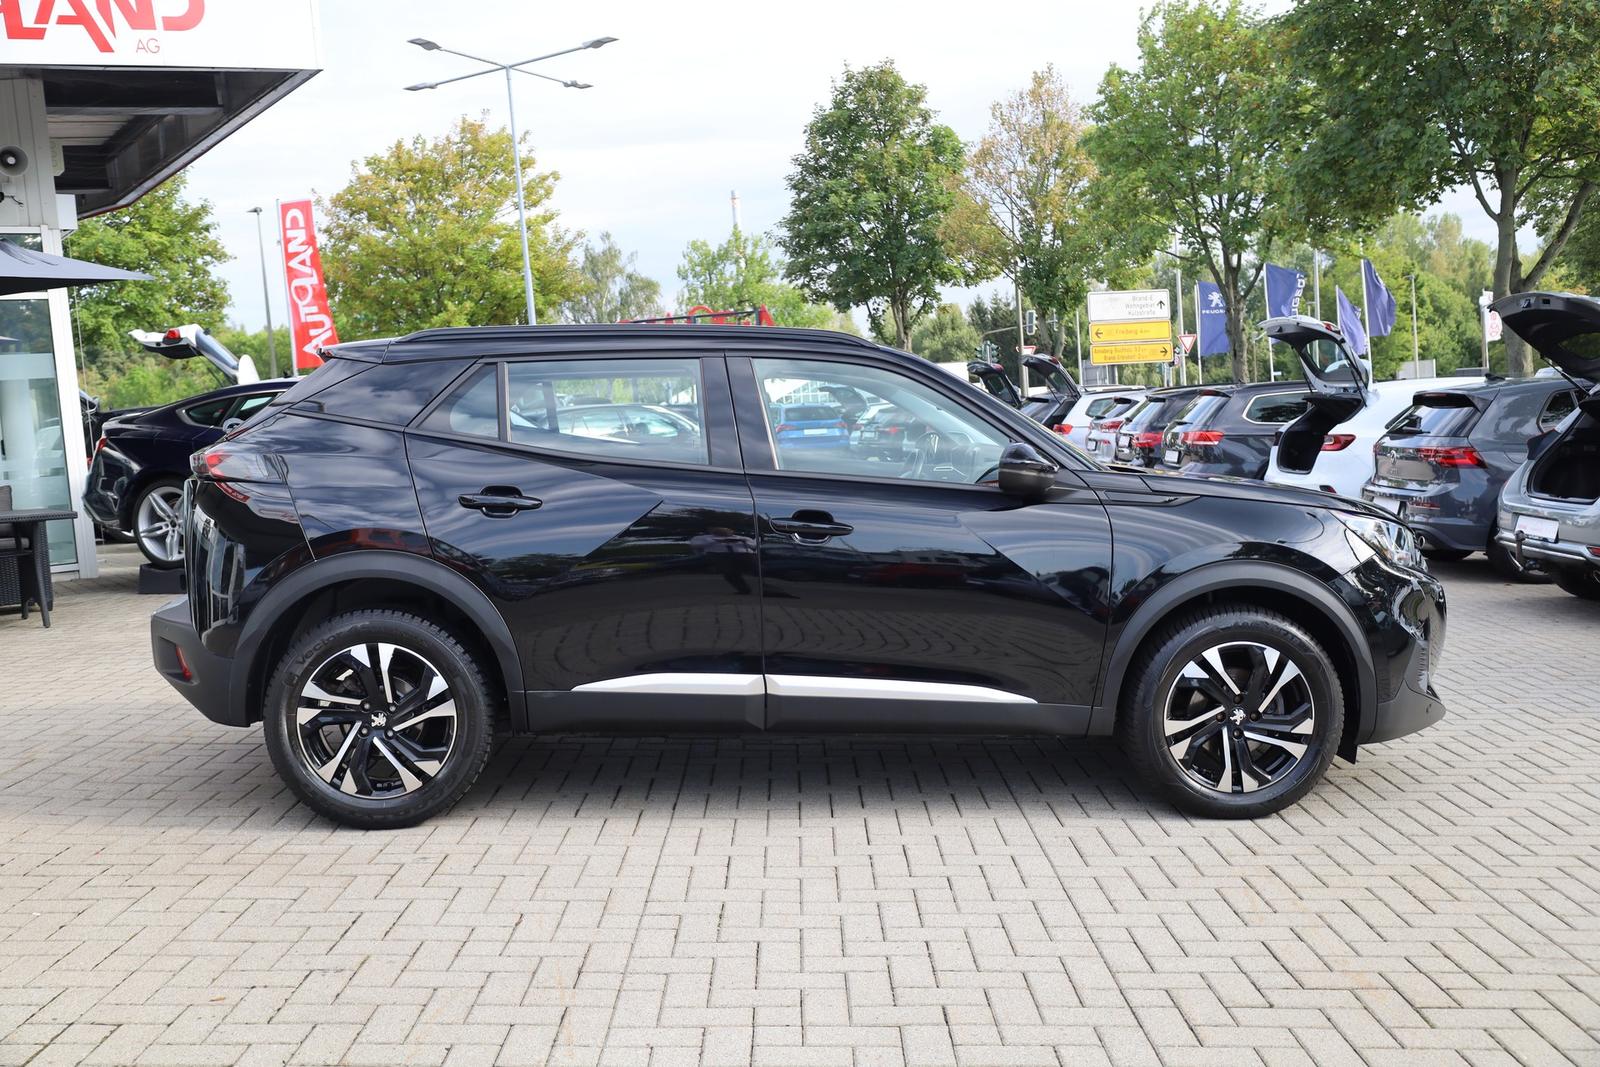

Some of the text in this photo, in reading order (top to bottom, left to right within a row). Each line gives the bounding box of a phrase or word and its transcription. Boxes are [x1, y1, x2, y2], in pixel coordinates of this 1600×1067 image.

[0, 0, 206, 53] LAND
[135, 38, 161, 54] AG
[285, 208, 333, 355] AUTOLAND
